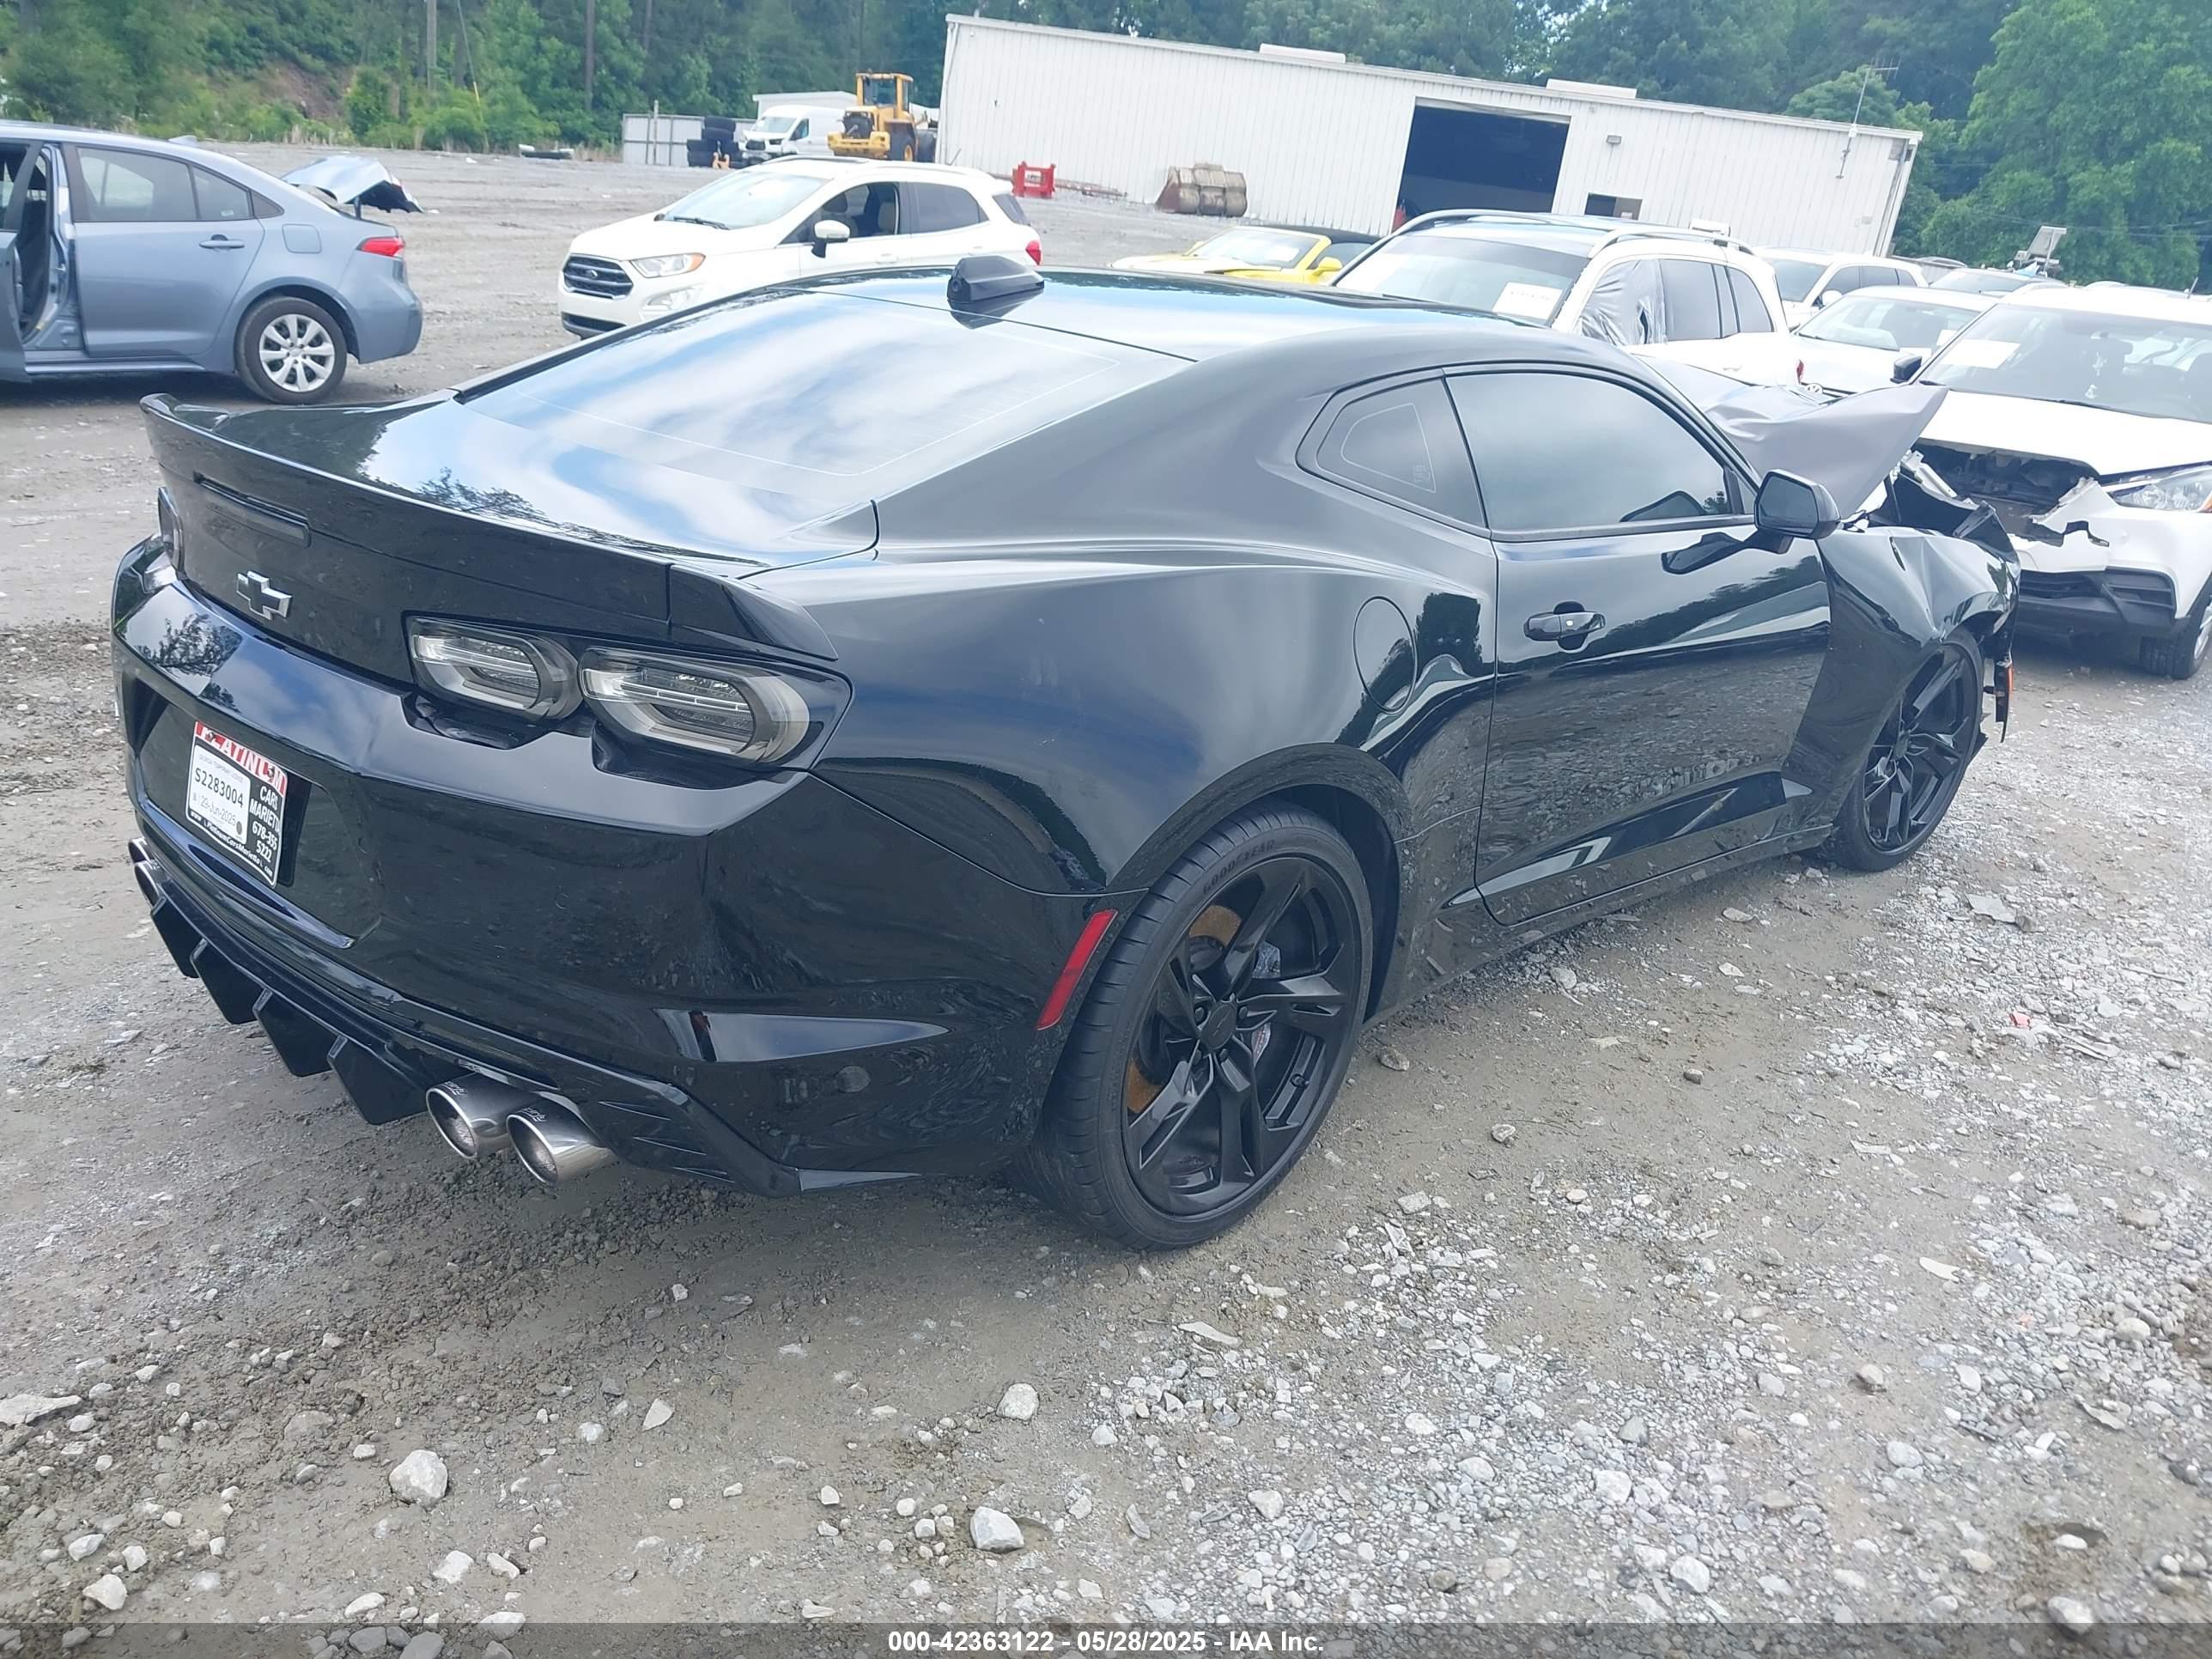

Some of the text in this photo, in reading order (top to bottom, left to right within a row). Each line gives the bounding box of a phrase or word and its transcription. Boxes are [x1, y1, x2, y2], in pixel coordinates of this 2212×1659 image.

[202, 726, 283, 792] PLATINUM
[195, 767, 244, 808] S2283004
[260, 785, 278, 811] CARS
[249, 798, 281, 834] MARIETTA
[1201, 838, 1277, 896] GOODYEAR
